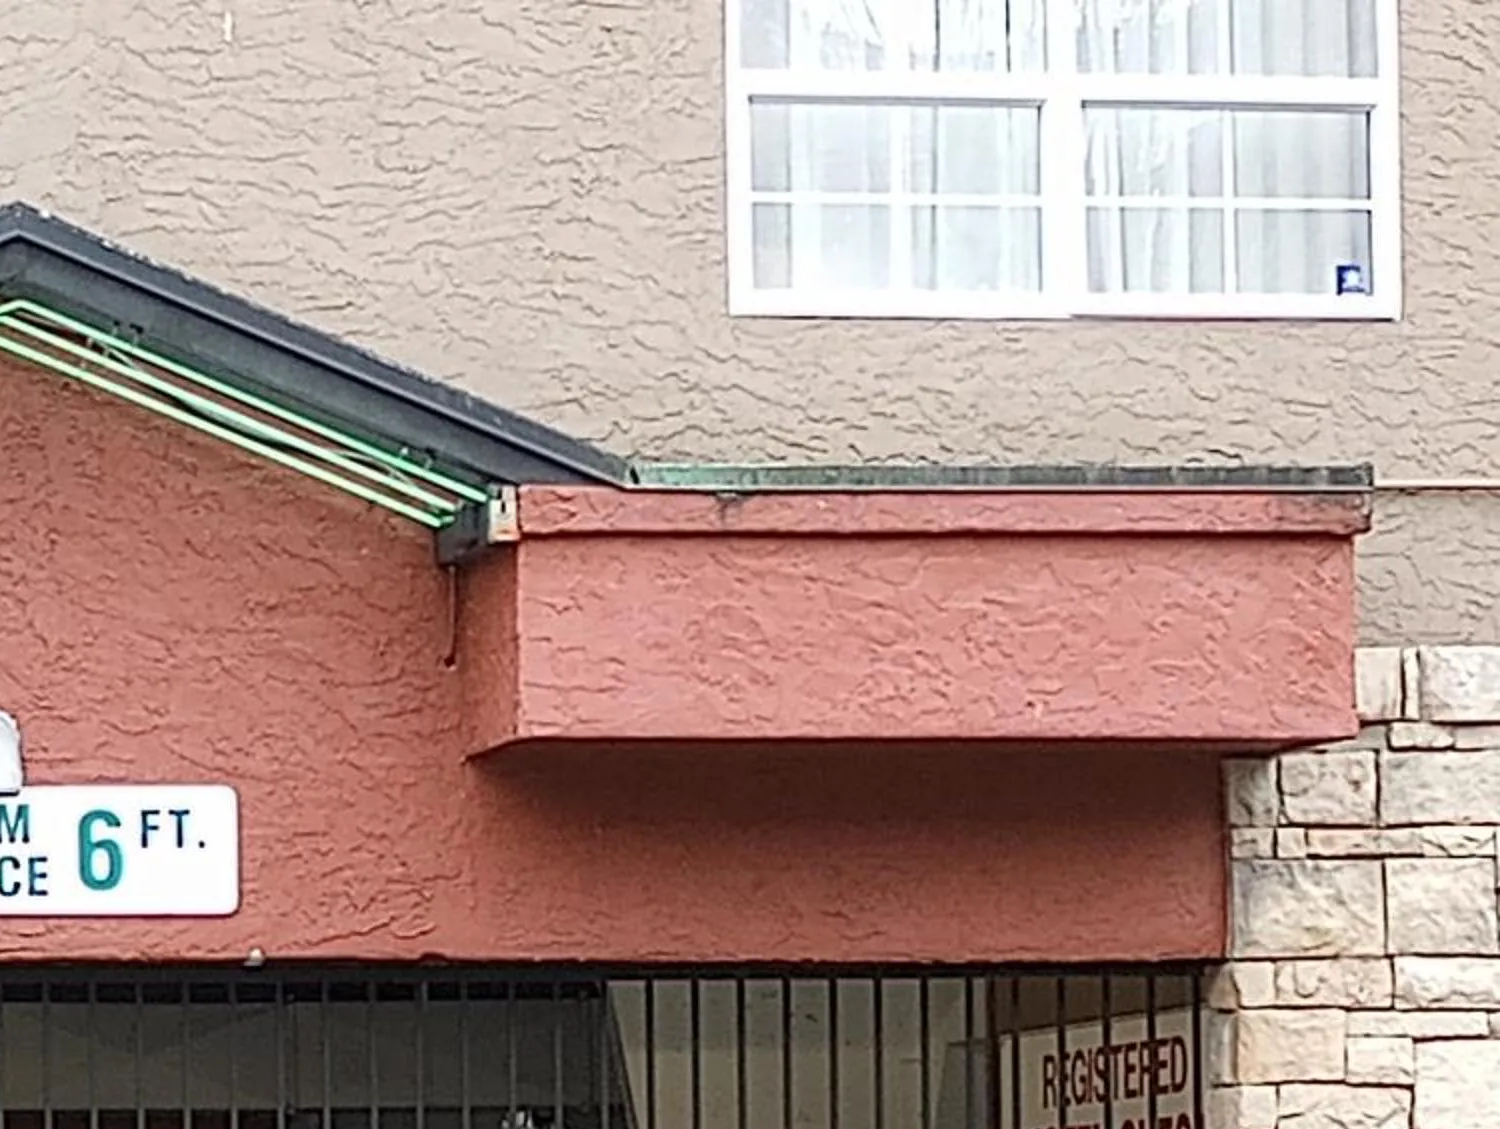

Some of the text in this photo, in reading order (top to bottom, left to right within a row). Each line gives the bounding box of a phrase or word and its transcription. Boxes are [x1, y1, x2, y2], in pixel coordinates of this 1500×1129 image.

[78, 809, 206, 891] 6 FT.
[1042, 1036, 1188, 1109] REGISTERED
